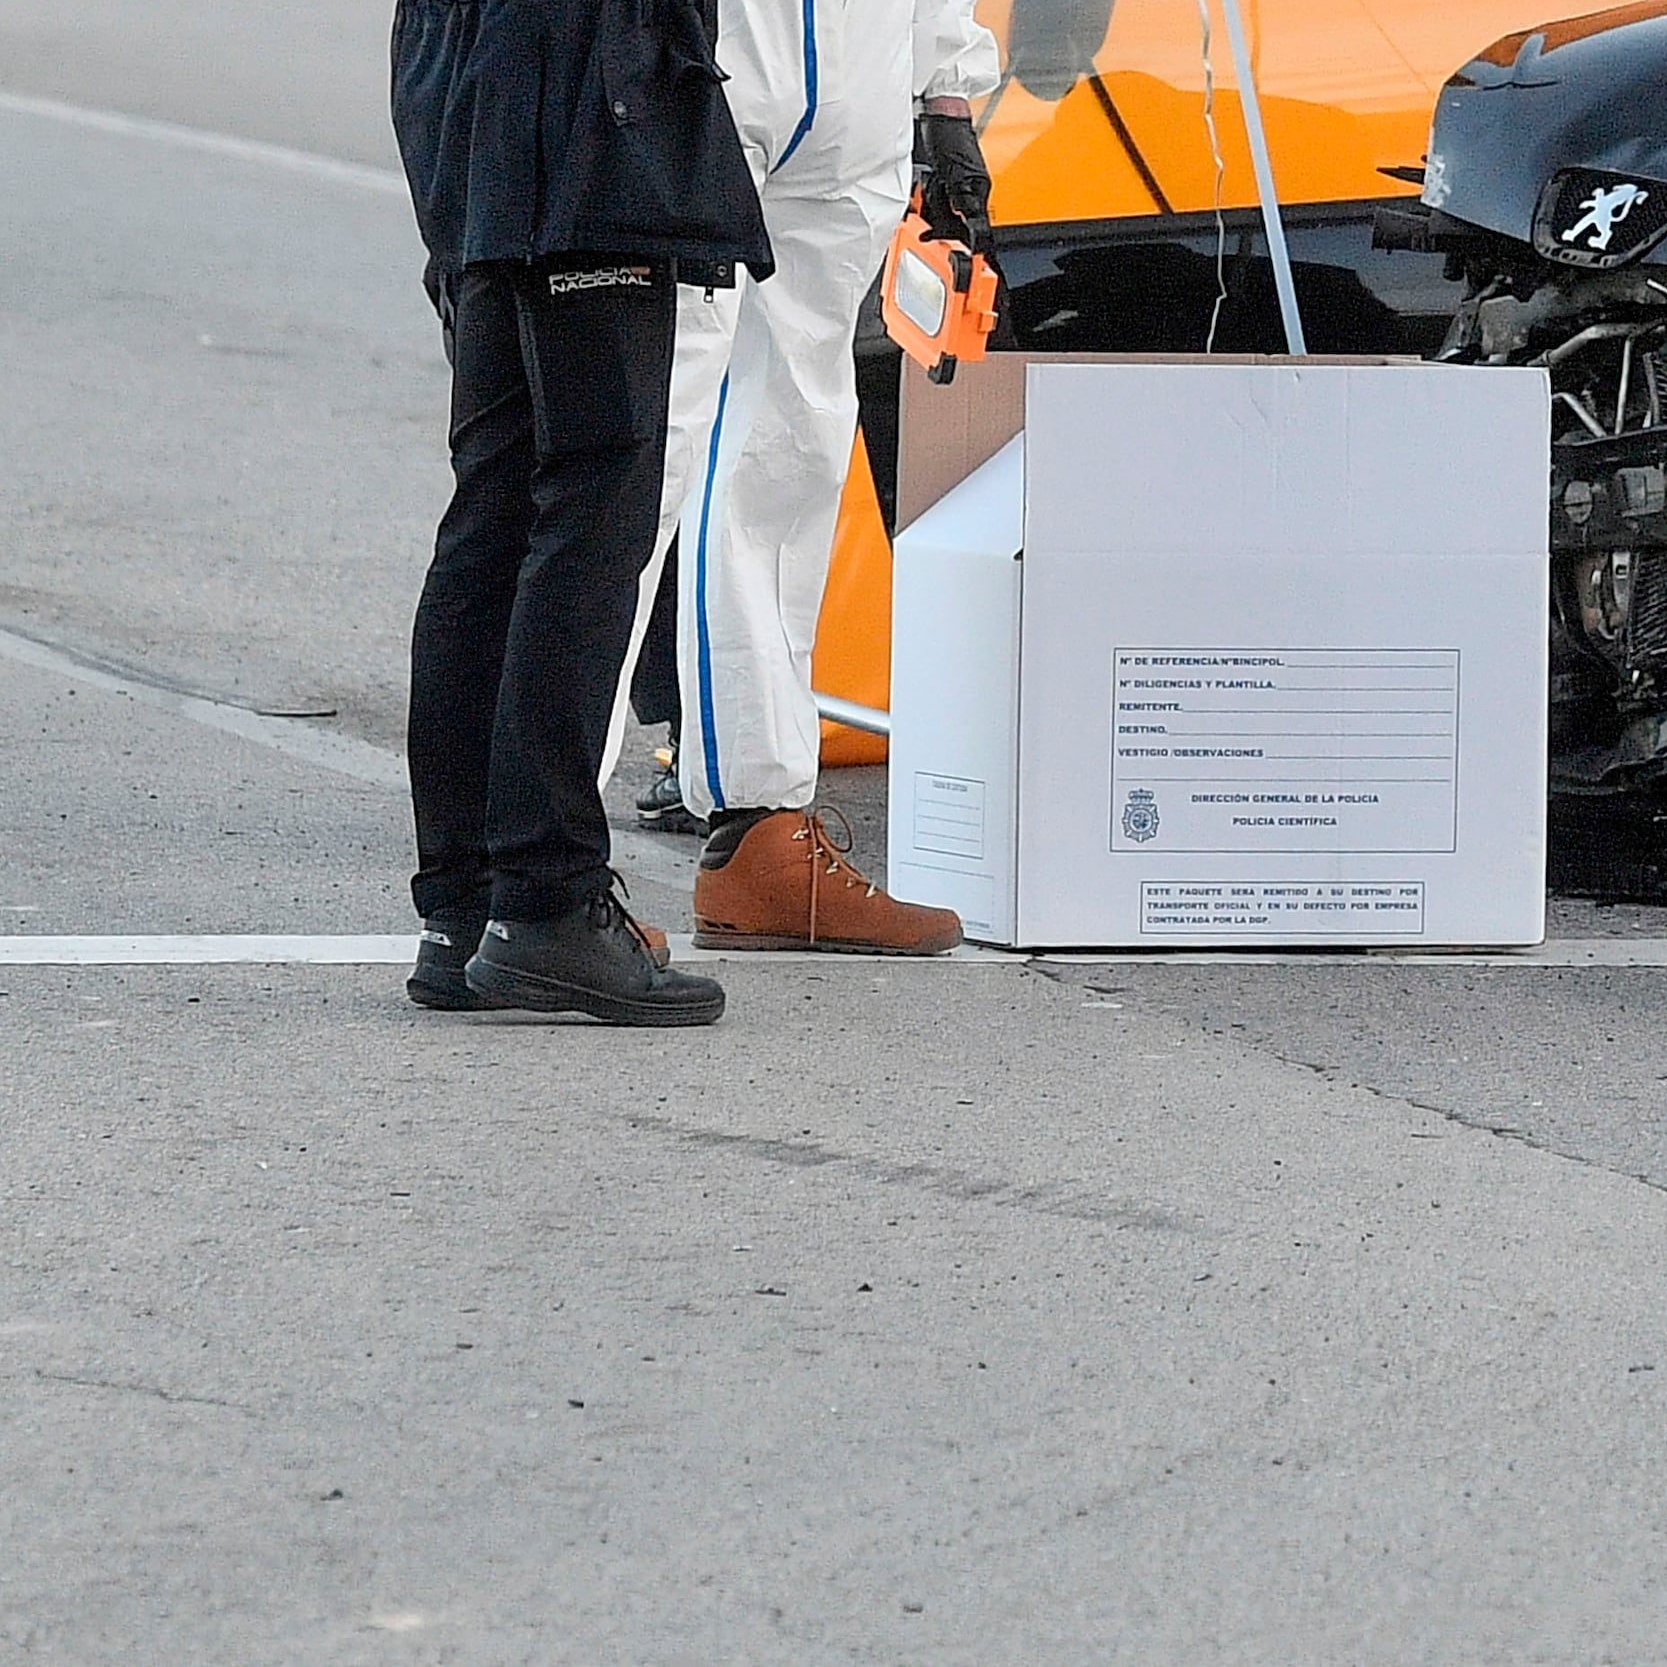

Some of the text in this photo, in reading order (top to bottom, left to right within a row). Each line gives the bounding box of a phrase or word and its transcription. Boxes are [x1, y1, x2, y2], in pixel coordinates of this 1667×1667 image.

[550, 275, 652, 295] NACIONAL
[1134, 656, 1149, 666] DE
[1134, 679, 1203, 690] DILIGENCIAS
[1205, 679, 1213, 689] Y
[1117, 747, 1169, 758] VESTIGIO
[1252, 793, 1302, 804] GENERAL
[1304, 794, 1319, 804] DE
[1321, 793, 1335, 804] LA
[1399, 887, 1419, 897] POR
[1267, 901, 1281, 911] EN
[1350, 901, 1370, 911] POR
[1212, 915, 1233, 925] POR
[1233, 915, 1247, 925] LA
